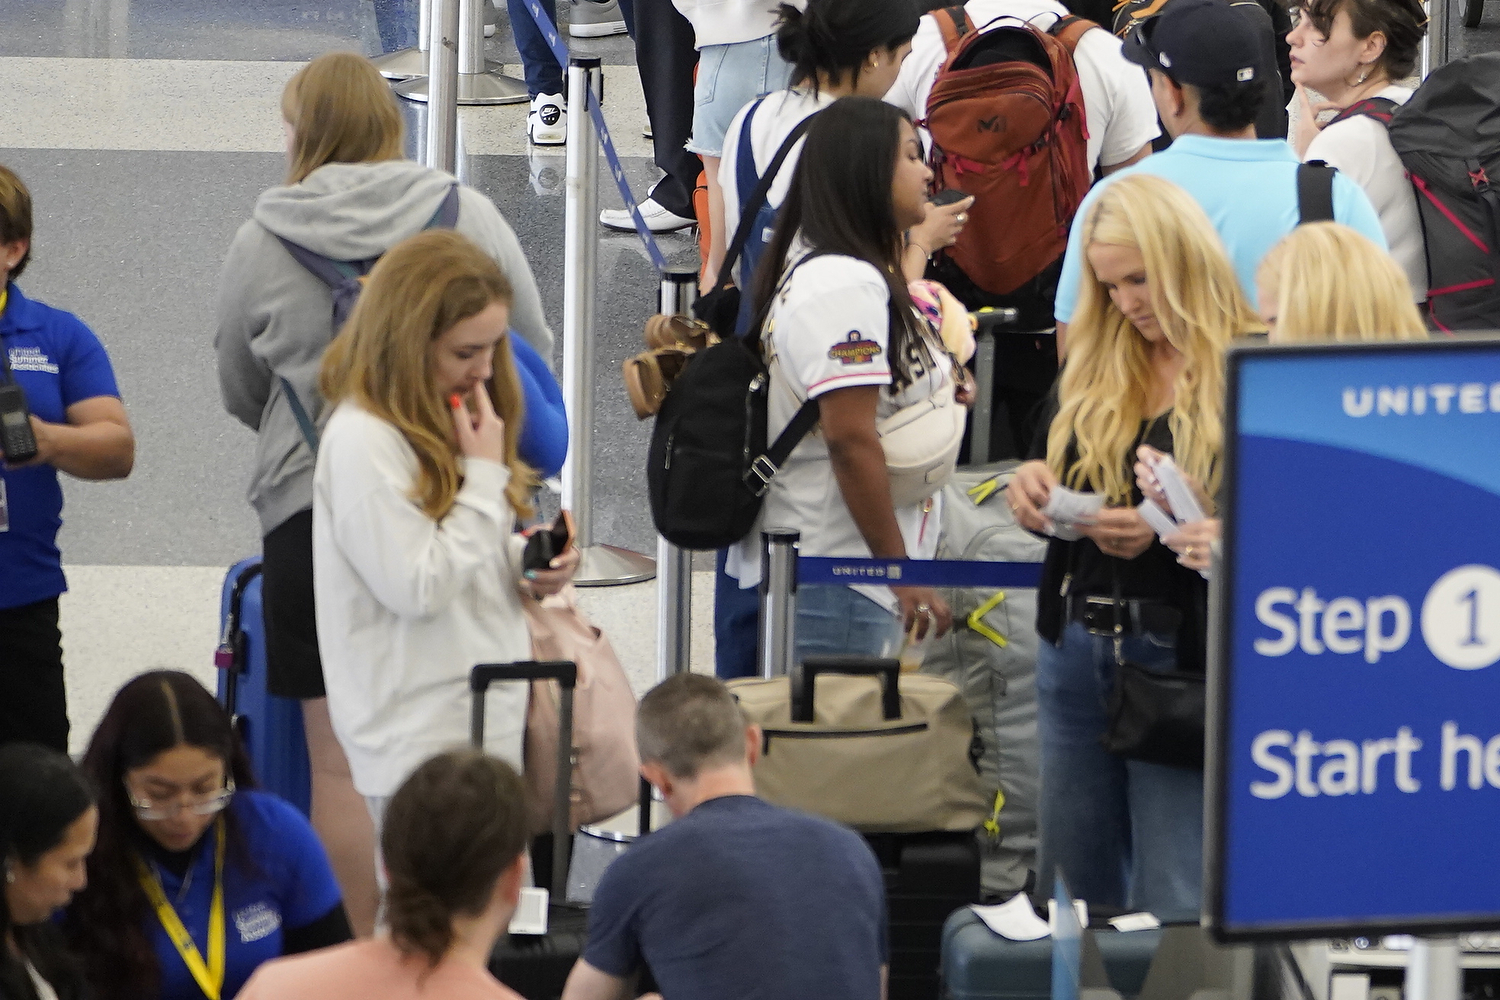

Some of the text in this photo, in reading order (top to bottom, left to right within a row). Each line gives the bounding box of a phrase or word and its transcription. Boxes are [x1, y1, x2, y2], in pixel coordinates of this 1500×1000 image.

[832, 566, 885, 576] UNITED
[1253, 586, 1412, 664] Step
[1249, 725, 1422, 799] Start
